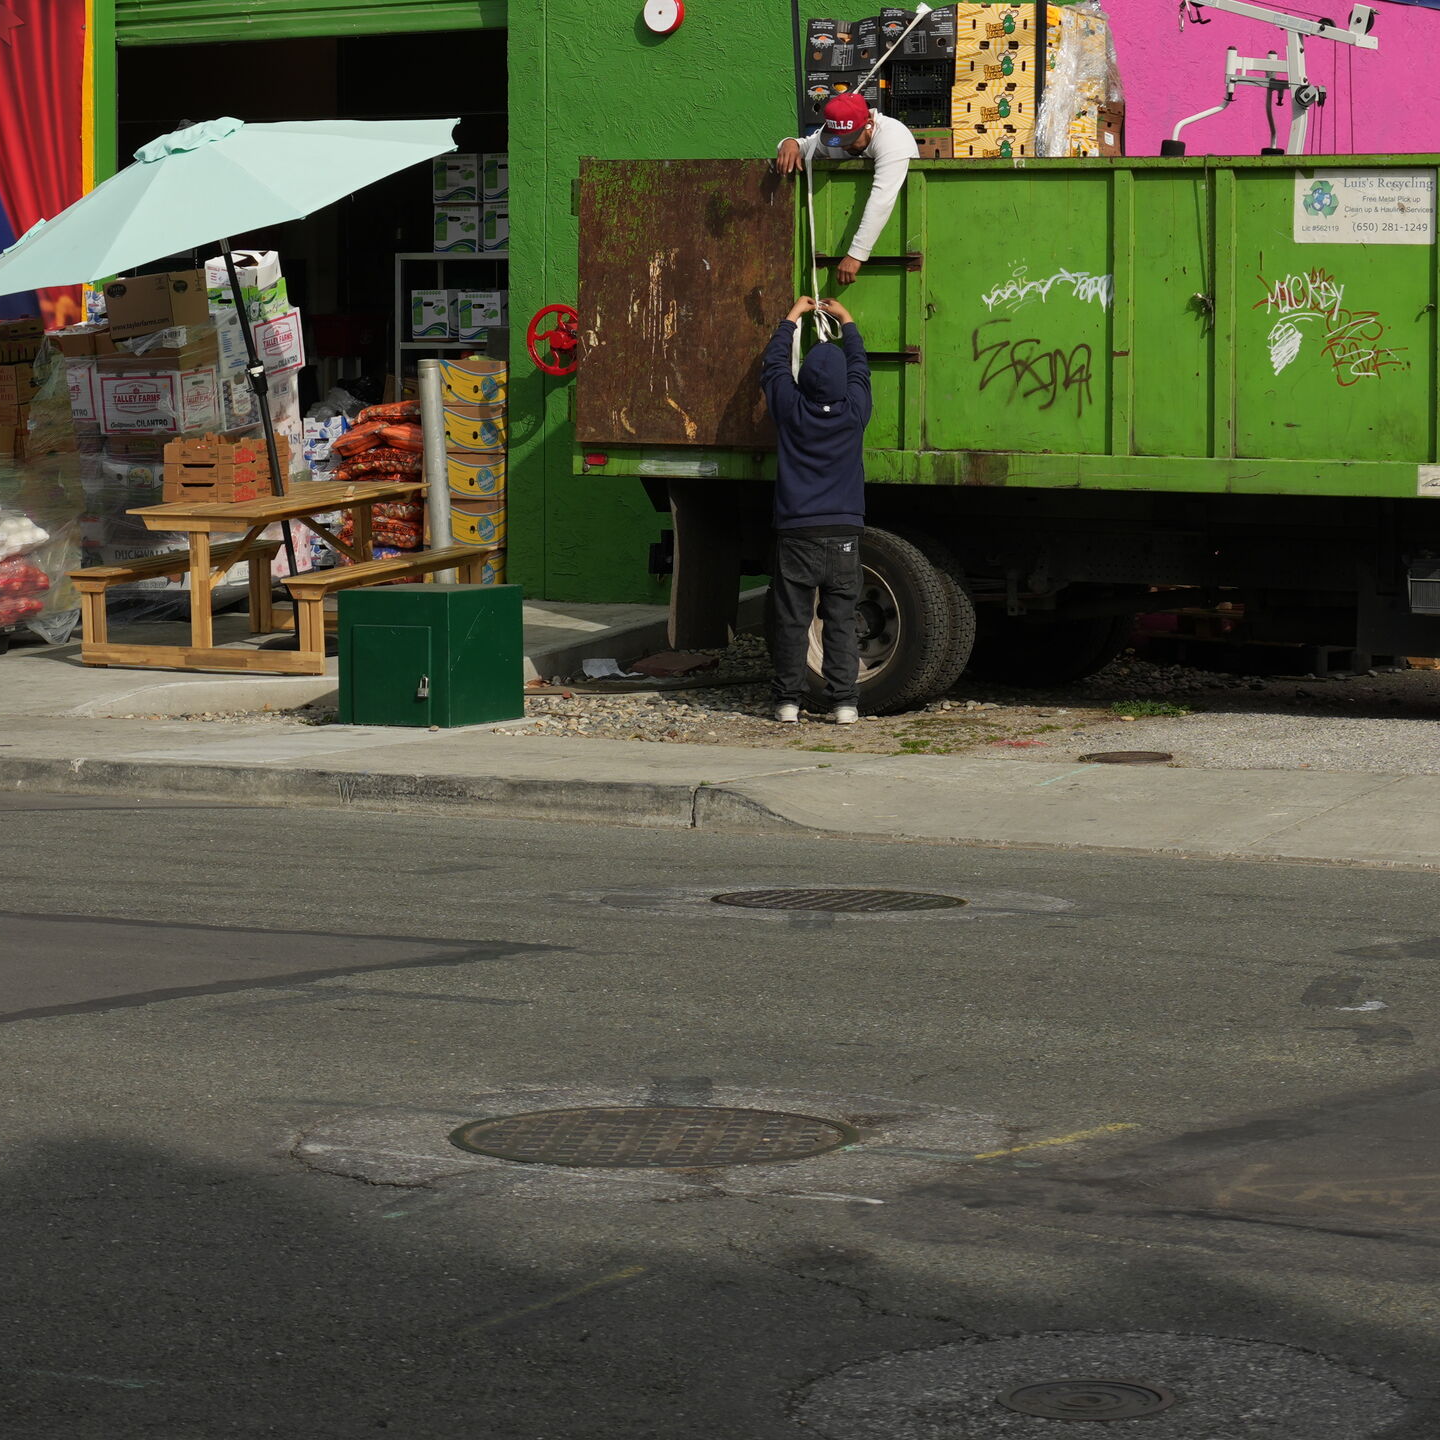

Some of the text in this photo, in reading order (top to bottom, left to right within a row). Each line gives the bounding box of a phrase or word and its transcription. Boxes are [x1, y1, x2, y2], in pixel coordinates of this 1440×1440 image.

[1343, 176, 1434, 192] Luis's Recycling
[1362, 195, 1421, 205] Free Metal Pick up
[1380, 206, 1405, 215] Hauling
[1406, 206, 1434, 214] Services
[1352, 222, 1428, 233] (650) 281-1249
[263, 332, 293, 347] TALLEY FARMS
[113, 393, 161, 403] TALLEY FARMS
[136, 418, 168, 427] CILANTRO
